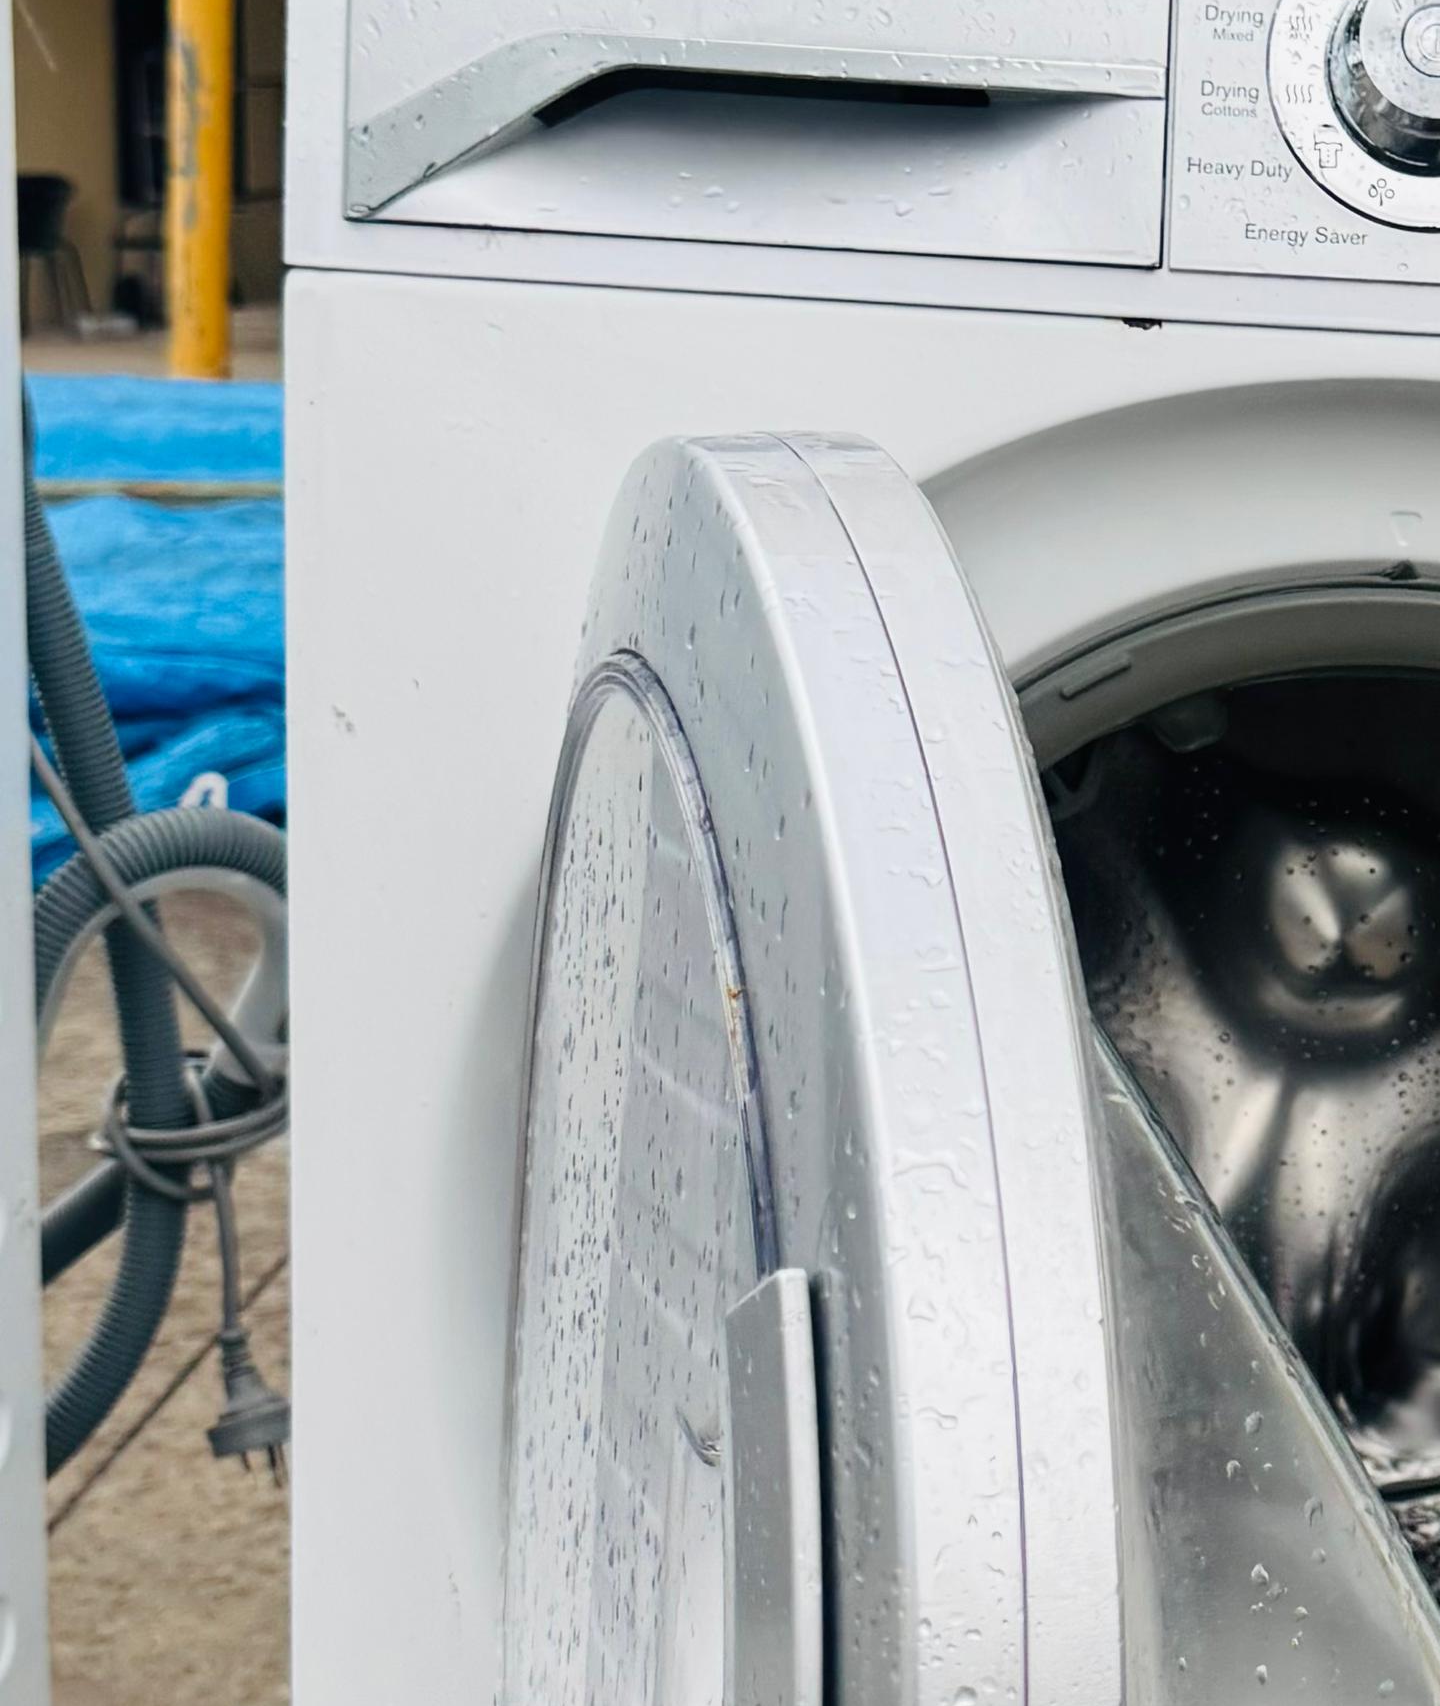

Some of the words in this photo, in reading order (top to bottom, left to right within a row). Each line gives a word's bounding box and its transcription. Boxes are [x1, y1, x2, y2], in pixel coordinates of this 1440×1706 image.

[1204, 4, 1265, 29] Drying
[1212, 27, 1255, 42] Mixed
[1200, 79, 1260, 105] Drying
[1200, 102, 1258, 119] Cottons
[1186, 157, 1245, 182] Heavy
[1250, 160, 1294, 183] Duty
[1244, 223, 1309, 248] Energy
[1314, 226, 1368, 246] Saver
